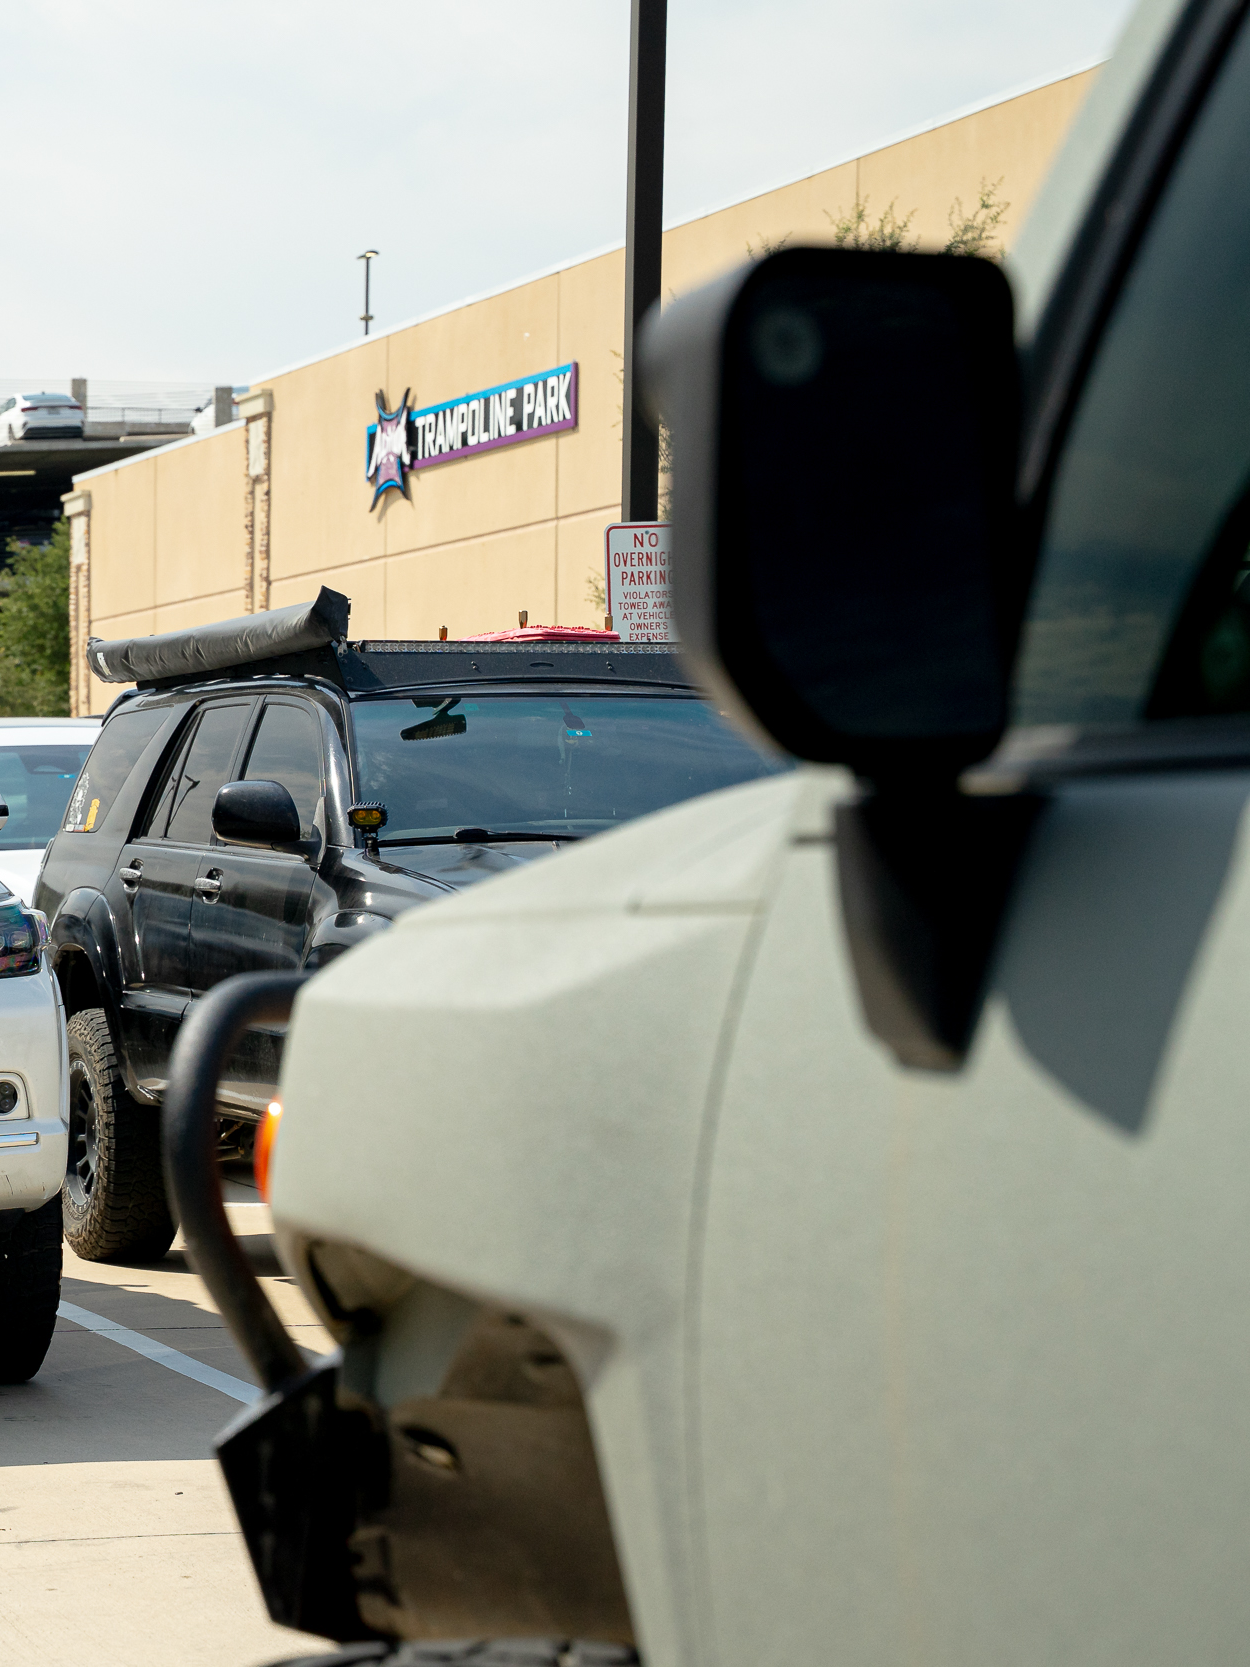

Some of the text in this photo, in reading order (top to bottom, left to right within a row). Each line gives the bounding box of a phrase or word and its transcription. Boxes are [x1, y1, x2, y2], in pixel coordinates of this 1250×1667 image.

[415, 388, 517, 461] TRAMPOLINE
[522, 371, 572, 432] PARK
[633, 532, 659, 548] NO
[614, 552, 672, 568] OVERNIG
[618, 601, 672, 611] TOWED AWA
[622, 612, 633, 621] AT
[629, 621, 668, 631] OWNER'S
[629, 632, 669, 641] EXPENSE
